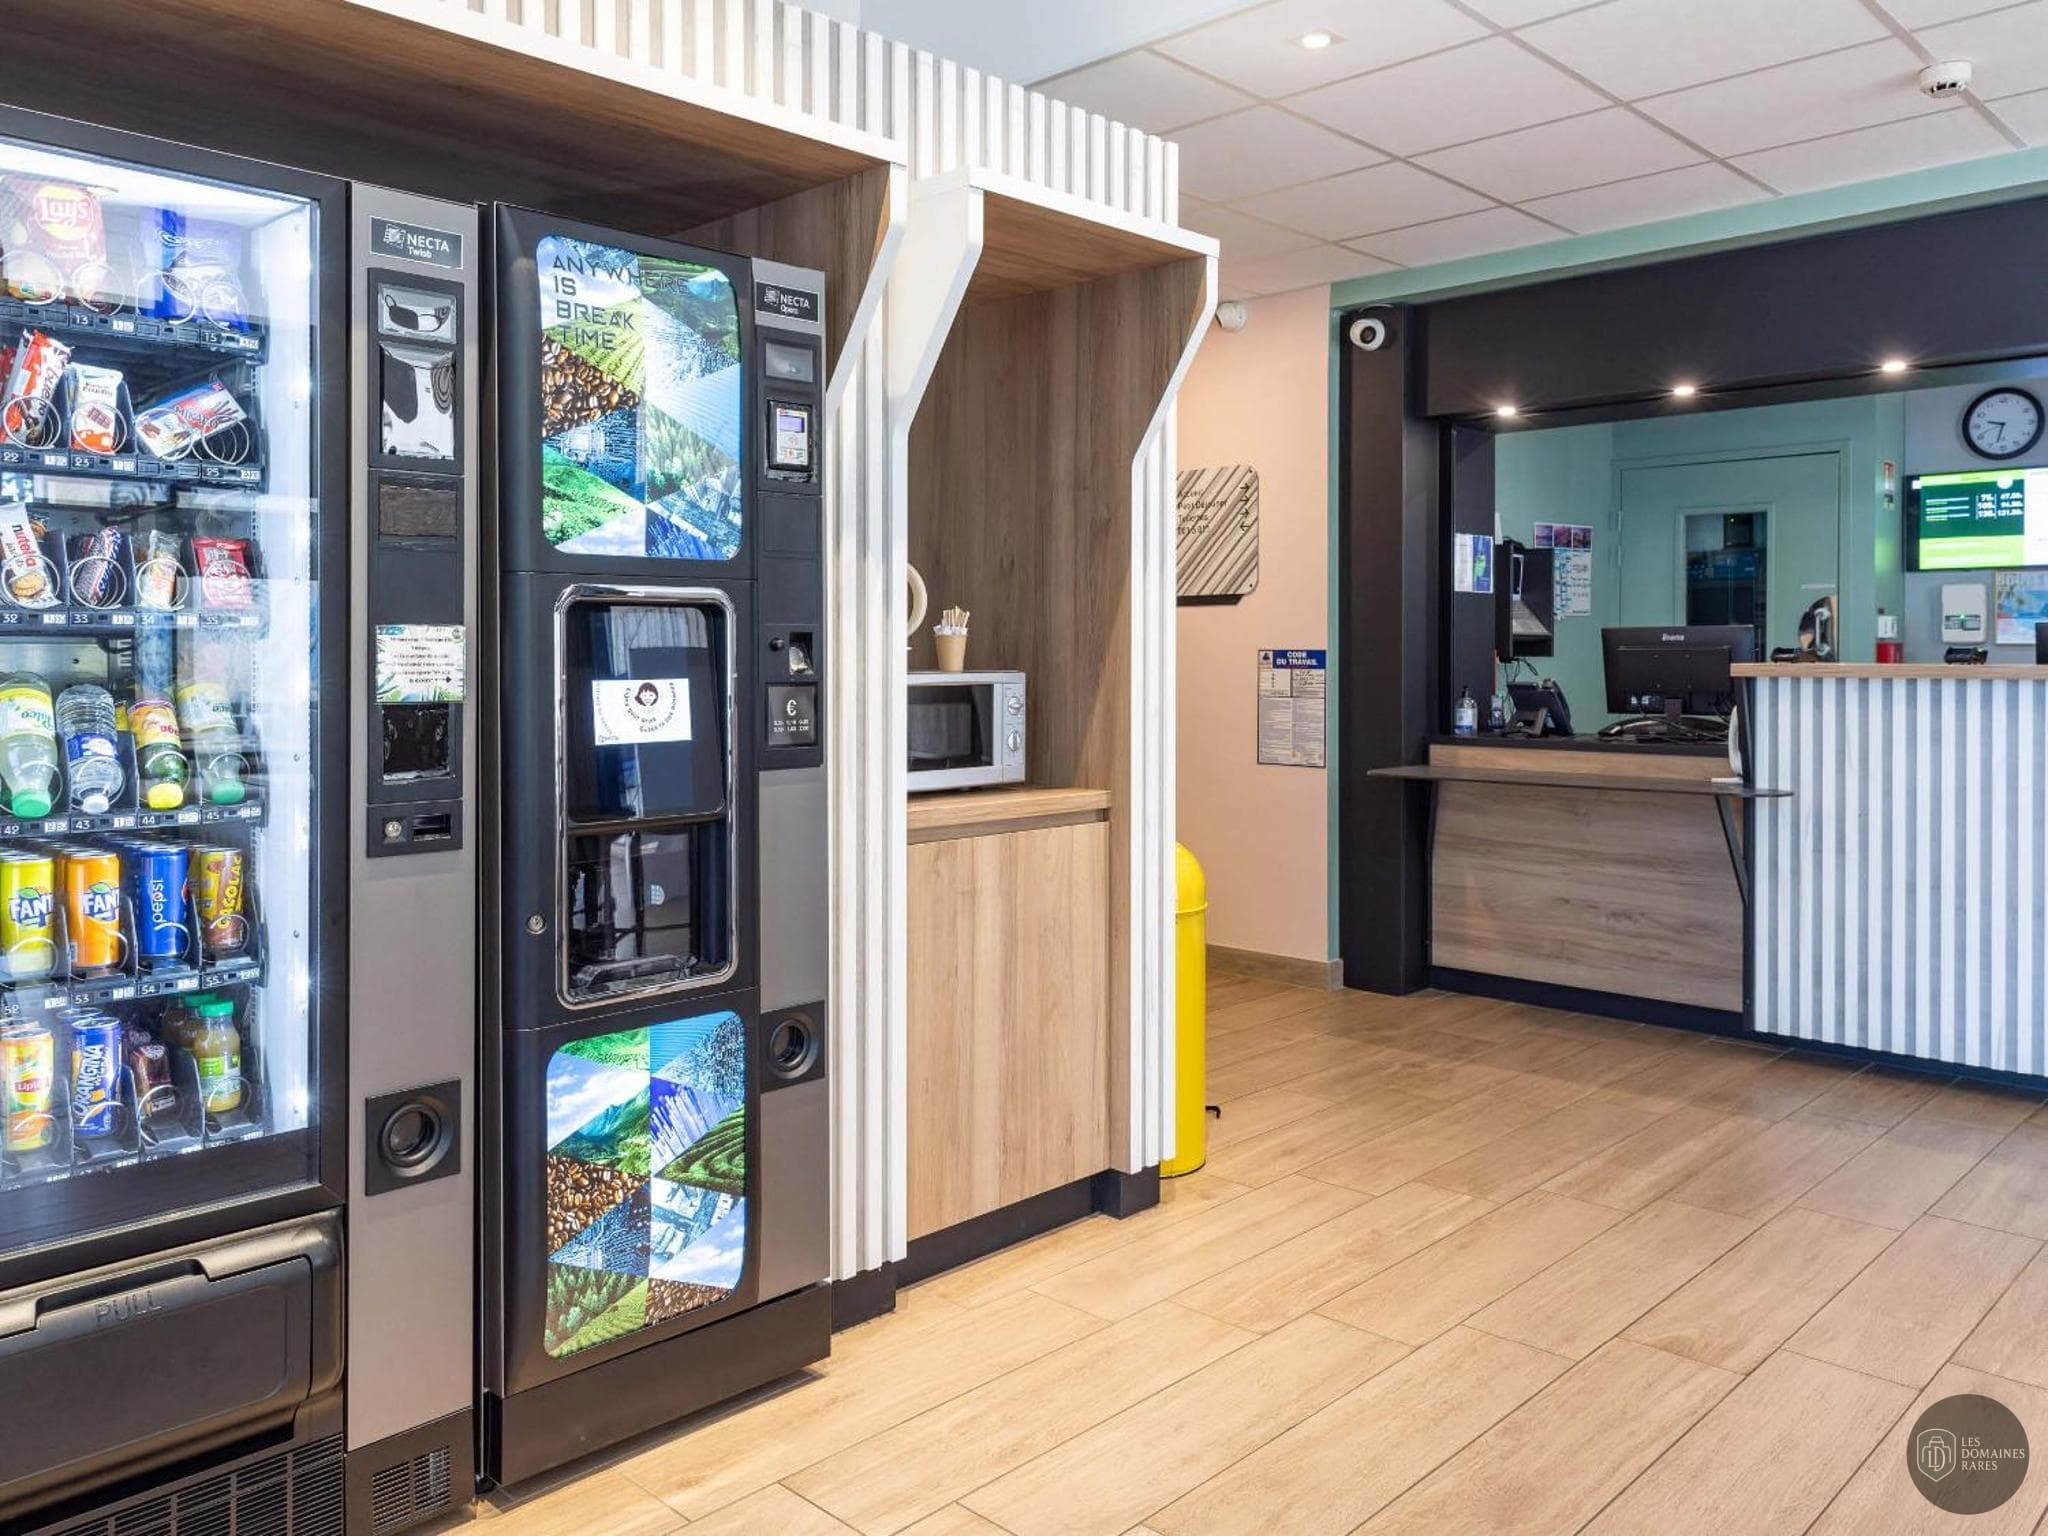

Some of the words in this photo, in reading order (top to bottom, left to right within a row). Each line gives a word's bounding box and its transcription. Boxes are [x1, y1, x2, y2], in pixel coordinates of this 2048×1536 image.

[407, 233, 450, 252] NECTA
[553, 255, 690, 296] ANYWHERE
[554, 275, 577, 297] IS
[780, 293, 811, 310] NECTA
[556, 300, 635, 331] BREAK
[557, 325, 617, 351] TIME
[74, 614, 88, 624] 33
[75, 820, 90, 830] 43
[10, 894, 54, 921] FANT
[151, 879, 168, 923] pepsi
[17, 1081, 41, 1092] Lipt
[73, 1044, 105, 1116] ORANGINA
[94, 1294, 163, 1326] PULL
